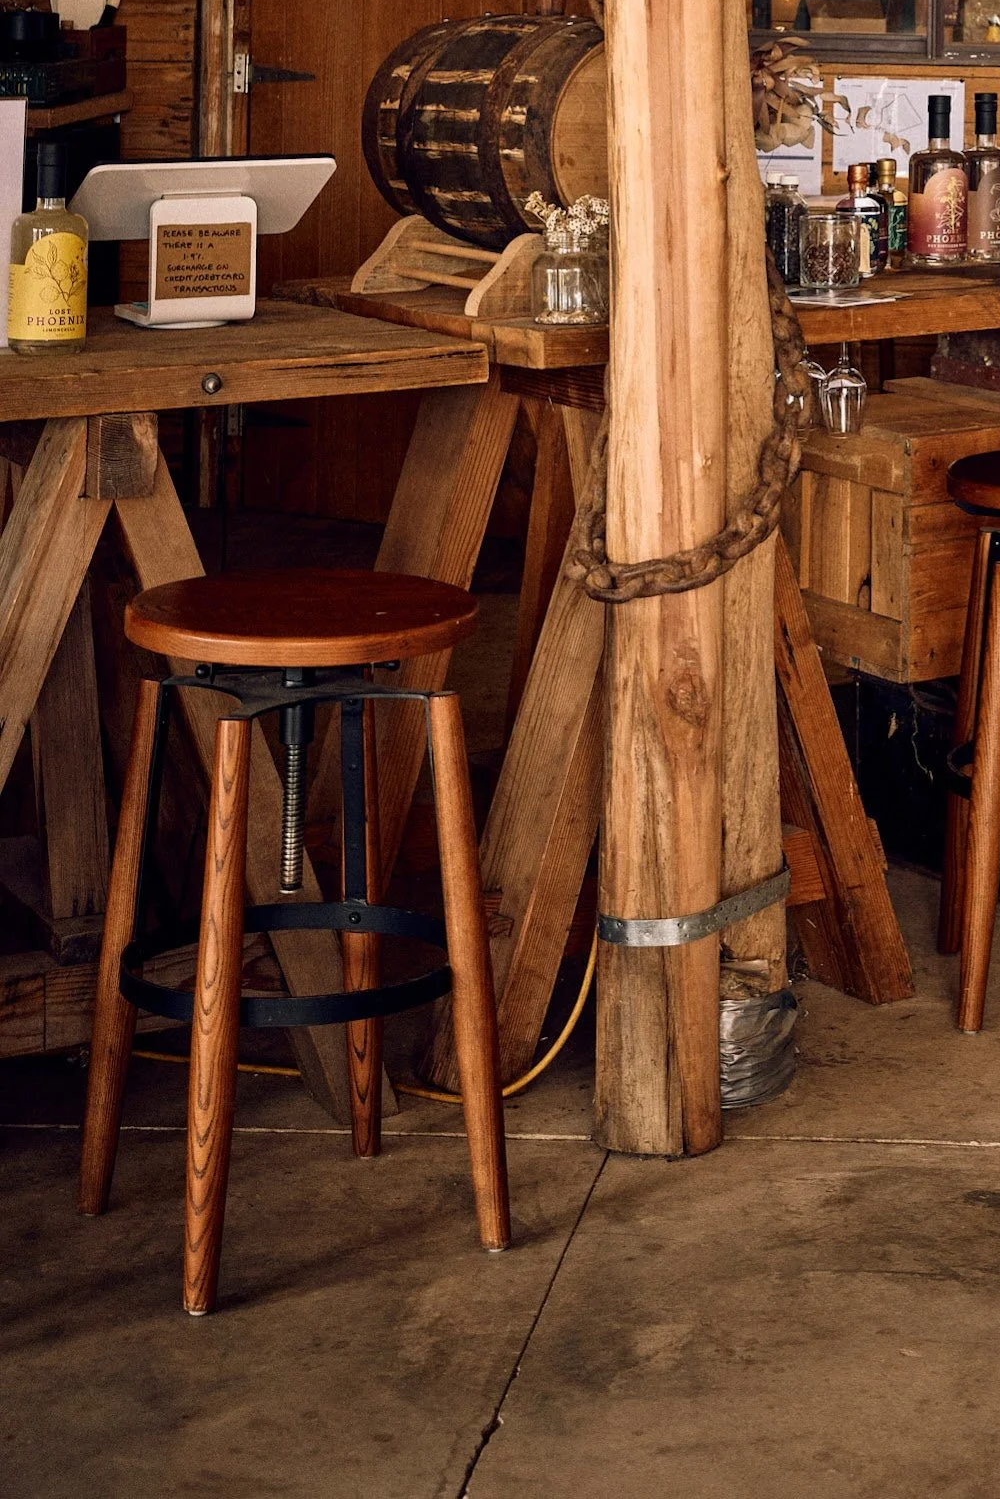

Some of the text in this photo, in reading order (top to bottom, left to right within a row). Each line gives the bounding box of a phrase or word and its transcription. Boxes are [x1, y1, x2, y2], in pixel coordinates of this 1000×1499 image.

[163, 230, 193, 238] PLEASE
[211, 229, 241, 237] AWARE
[167, 264, 213, 272] SURCHARGE
[221, 272, 245, 281] CARD
[173, 285, 237, 294] TRANSACTIONS
